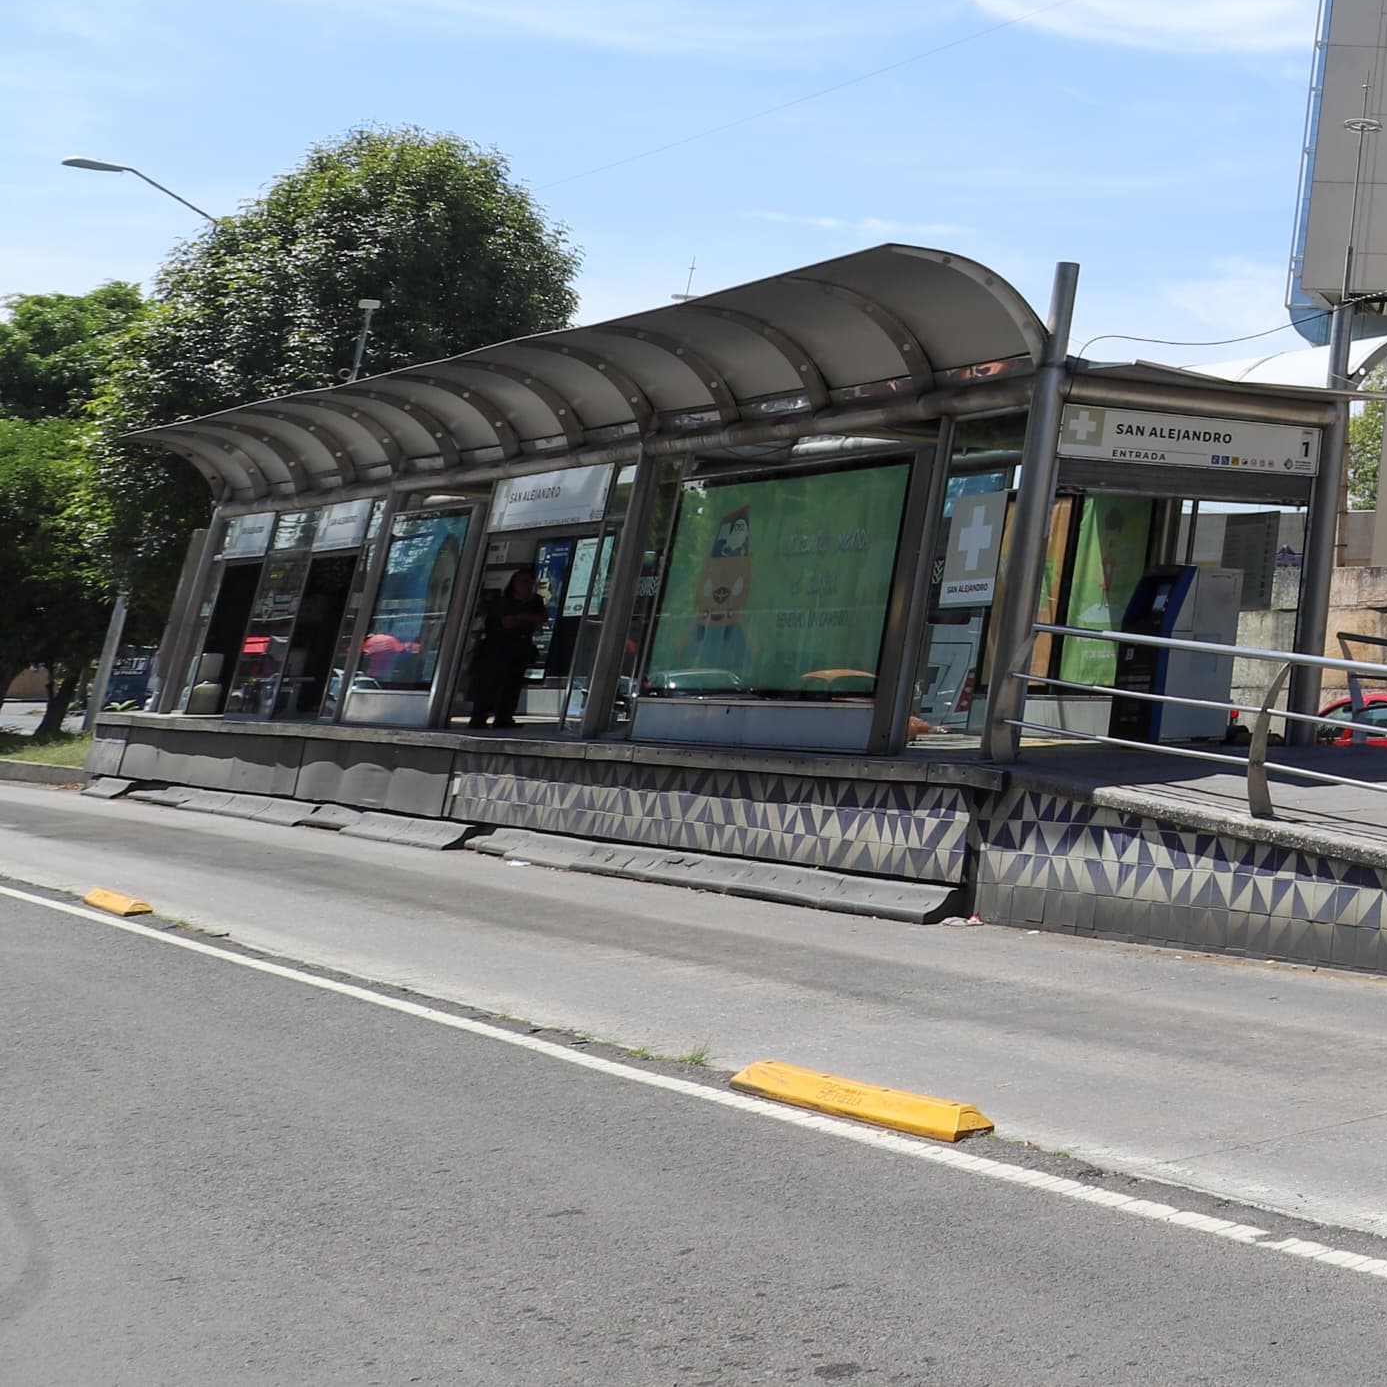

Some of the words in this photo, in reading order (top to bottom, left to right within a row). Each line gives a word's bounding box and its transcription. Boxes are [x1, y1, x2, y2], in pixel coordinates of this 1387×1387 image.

[1115, 423, 1145, 436] SAN
[1148, 427, 1232, 444] ALEJANDRO
[1112, 449, 1166, 461] ENTRADA
[1302, 441, 1310, 458] 1
[509, 491, 522, 504] SAN
[523, 486, 561, 502] ALEJANDRO
[947, 585, 958, 594] SAN
